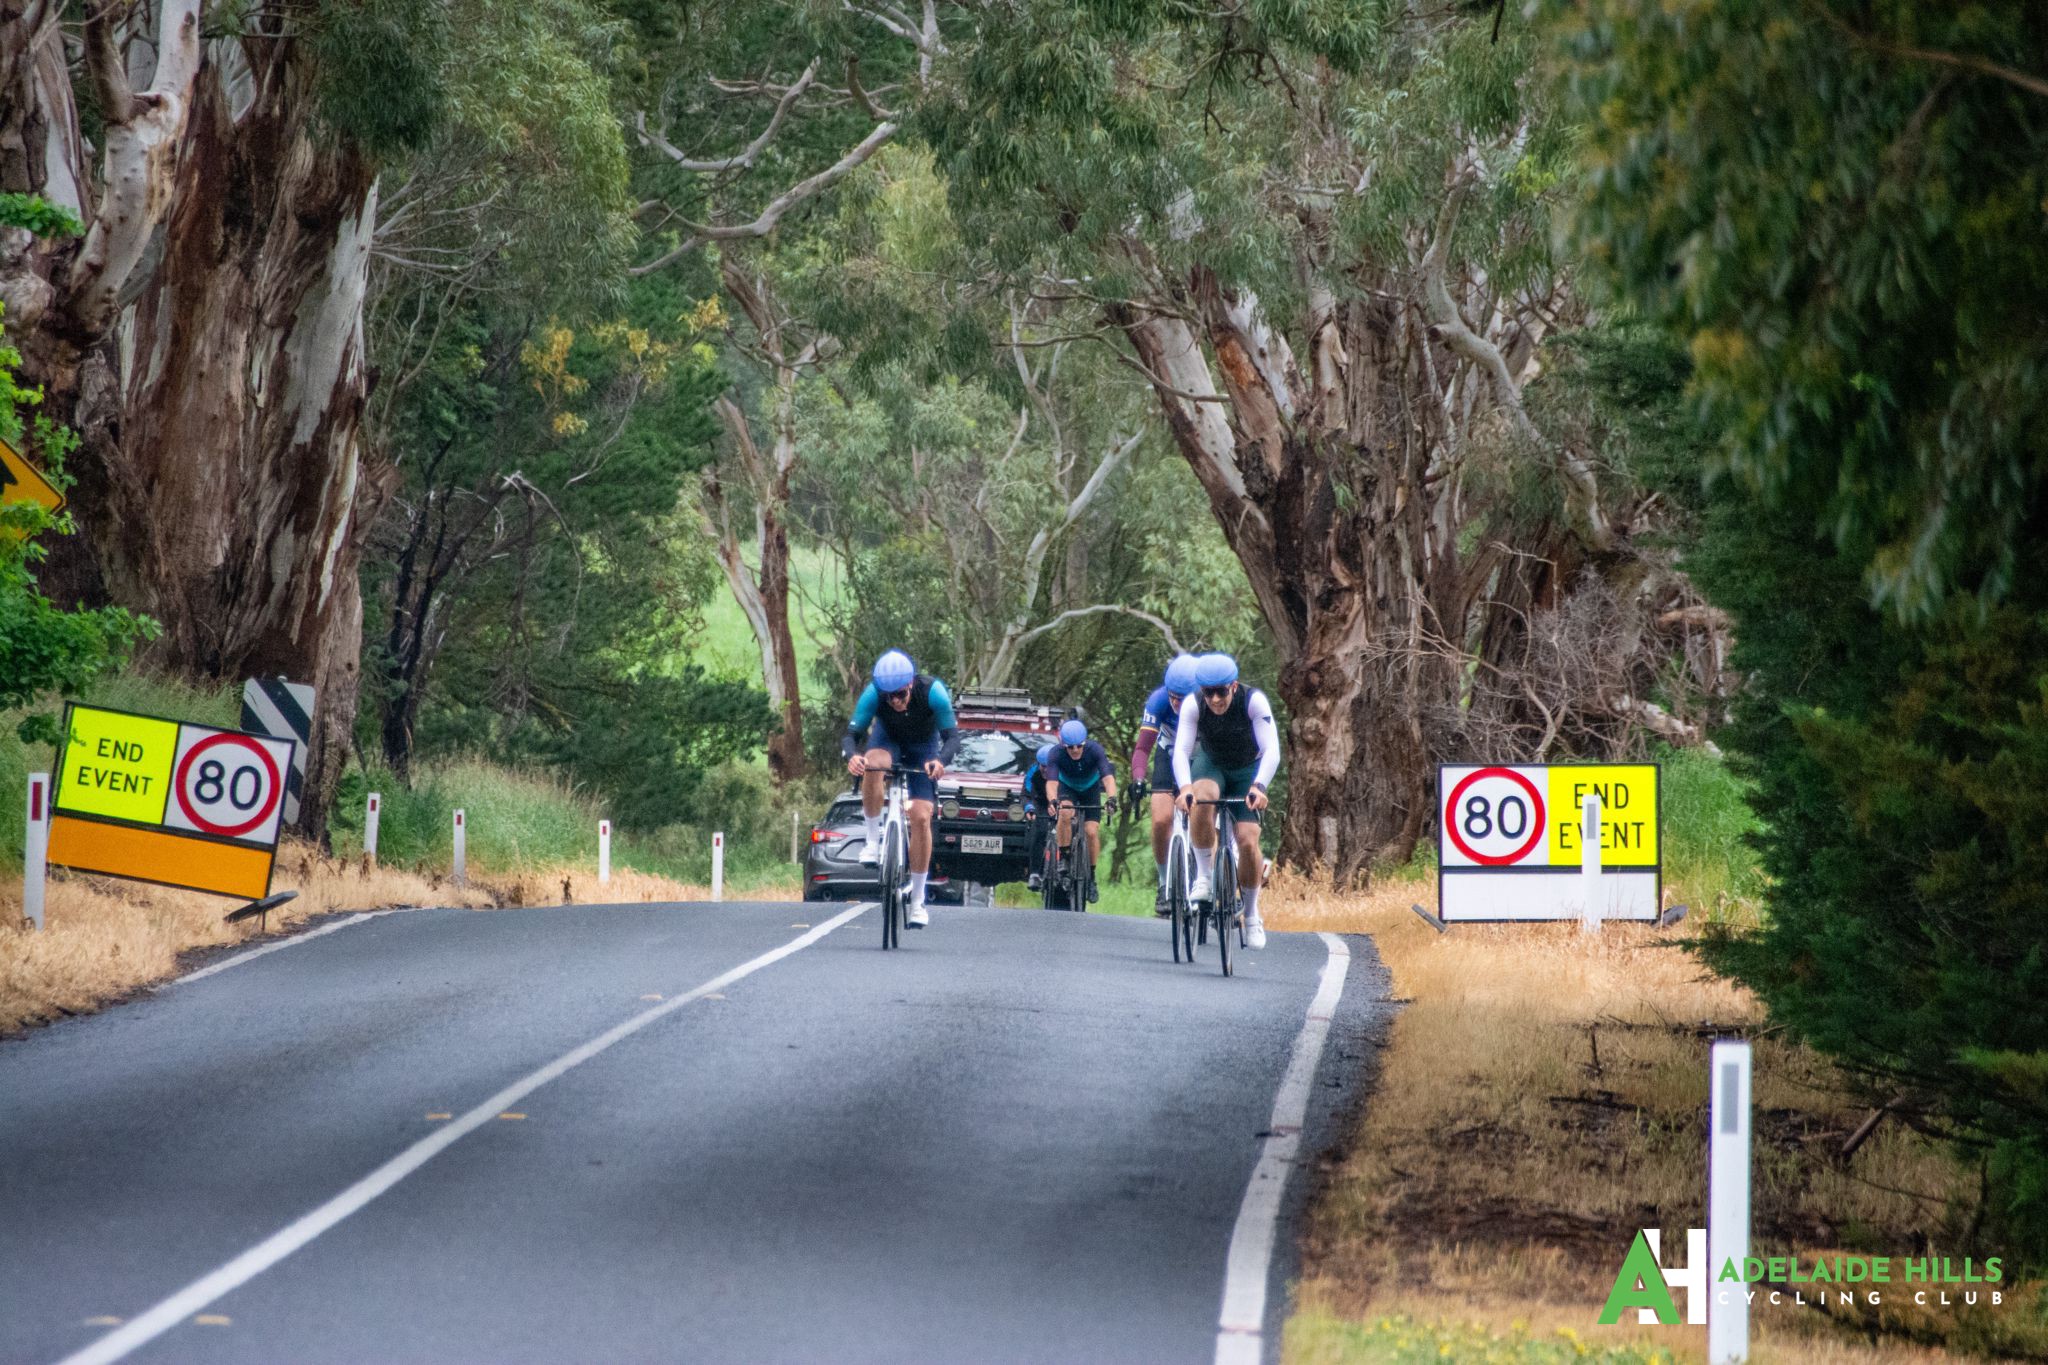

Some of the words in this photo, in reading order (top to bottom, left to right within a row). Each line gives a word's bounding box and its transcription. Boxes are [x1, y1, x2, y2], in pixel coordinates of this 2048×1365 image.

[96, 737, 144, 763] END
[77, 765, 153, 796] EVENT
[194, 759, 263, 811] 80
[1574, 783, 1629, 810] END
[1463, 795, 1528, 840] 80
